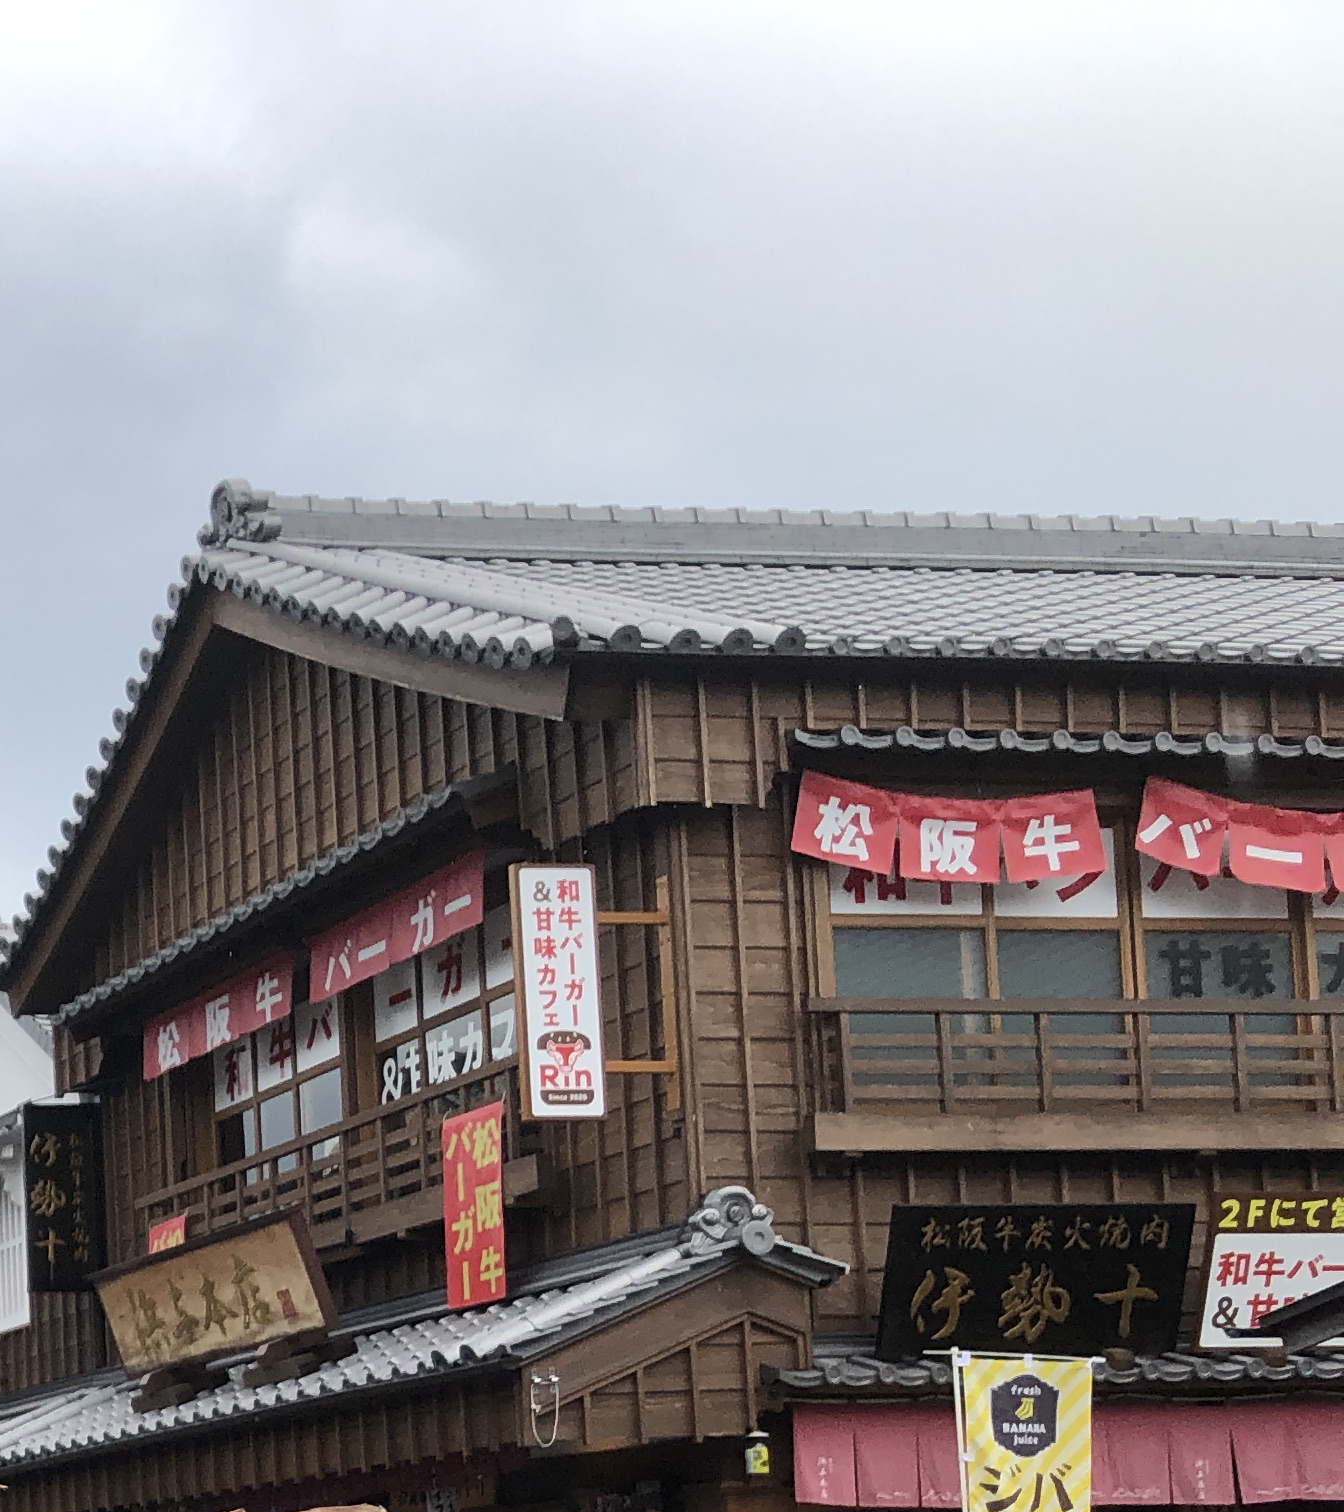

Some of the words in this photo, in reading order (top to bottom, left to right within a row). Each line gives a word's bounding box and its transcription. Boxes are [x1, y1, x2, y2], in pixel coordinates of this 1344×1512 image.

[813, 796, 1080, 875] 松阪牛
[1139, 814, 1302, 863] バー
[156, 972, 283, 1073] 松阪牛
[325, 889, 471, 991] バーガー
[532, 880, 560, 1027] &甘味カフェ
[557, 879, 585, 1027] 和牛バーガー
[539, 1064, 593, 1088] Rin
[445, 1121, 476, 1300] バーガー
[472, 1117, 504, 1295] 松阪牛
[920, 1214, 1170, 1252] 松阪牛炭火焼肉
[910, 1261, 1159, 1344] 伊勢十
